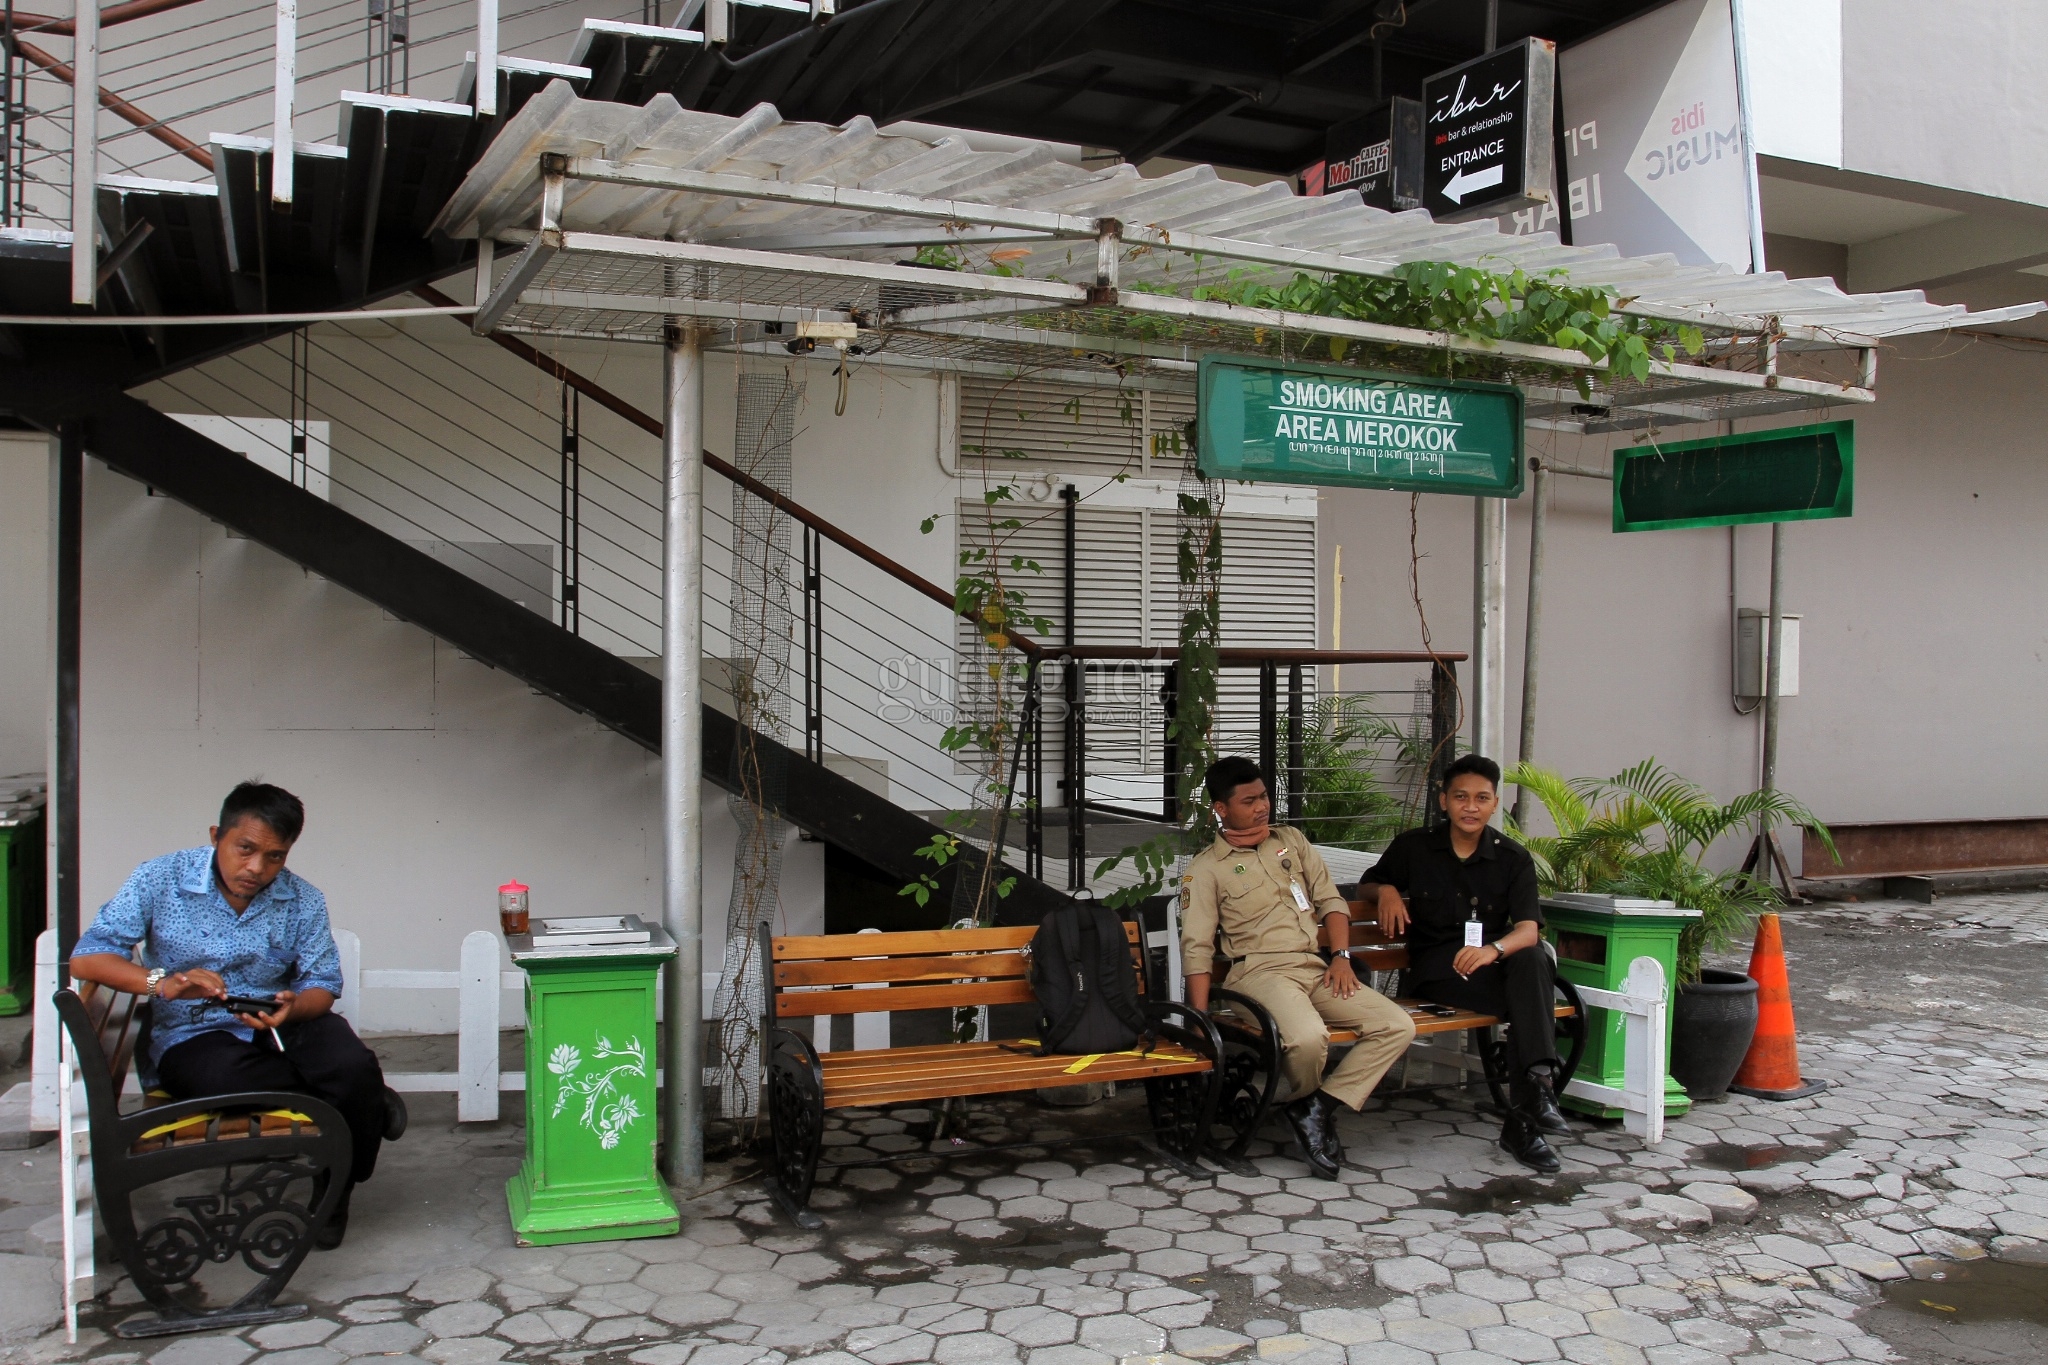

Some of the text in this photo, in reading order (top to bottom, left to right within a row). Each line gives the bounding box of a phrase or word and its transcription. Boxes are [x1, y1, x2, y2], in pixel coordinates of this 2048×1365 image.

[1448, 129, 1460, 142] bar
[1461, 126, 1467, 137] &
[1468, 111, 1513, 135] relationship
[1328, 147, 1389, 188] Molinari
[1441, 138, 1504, 172] ENTRANCE
[1280, 380, 1453, 420] SMOKING AREA
[1274, 413, 1458, 452] AREA MEROKOK
